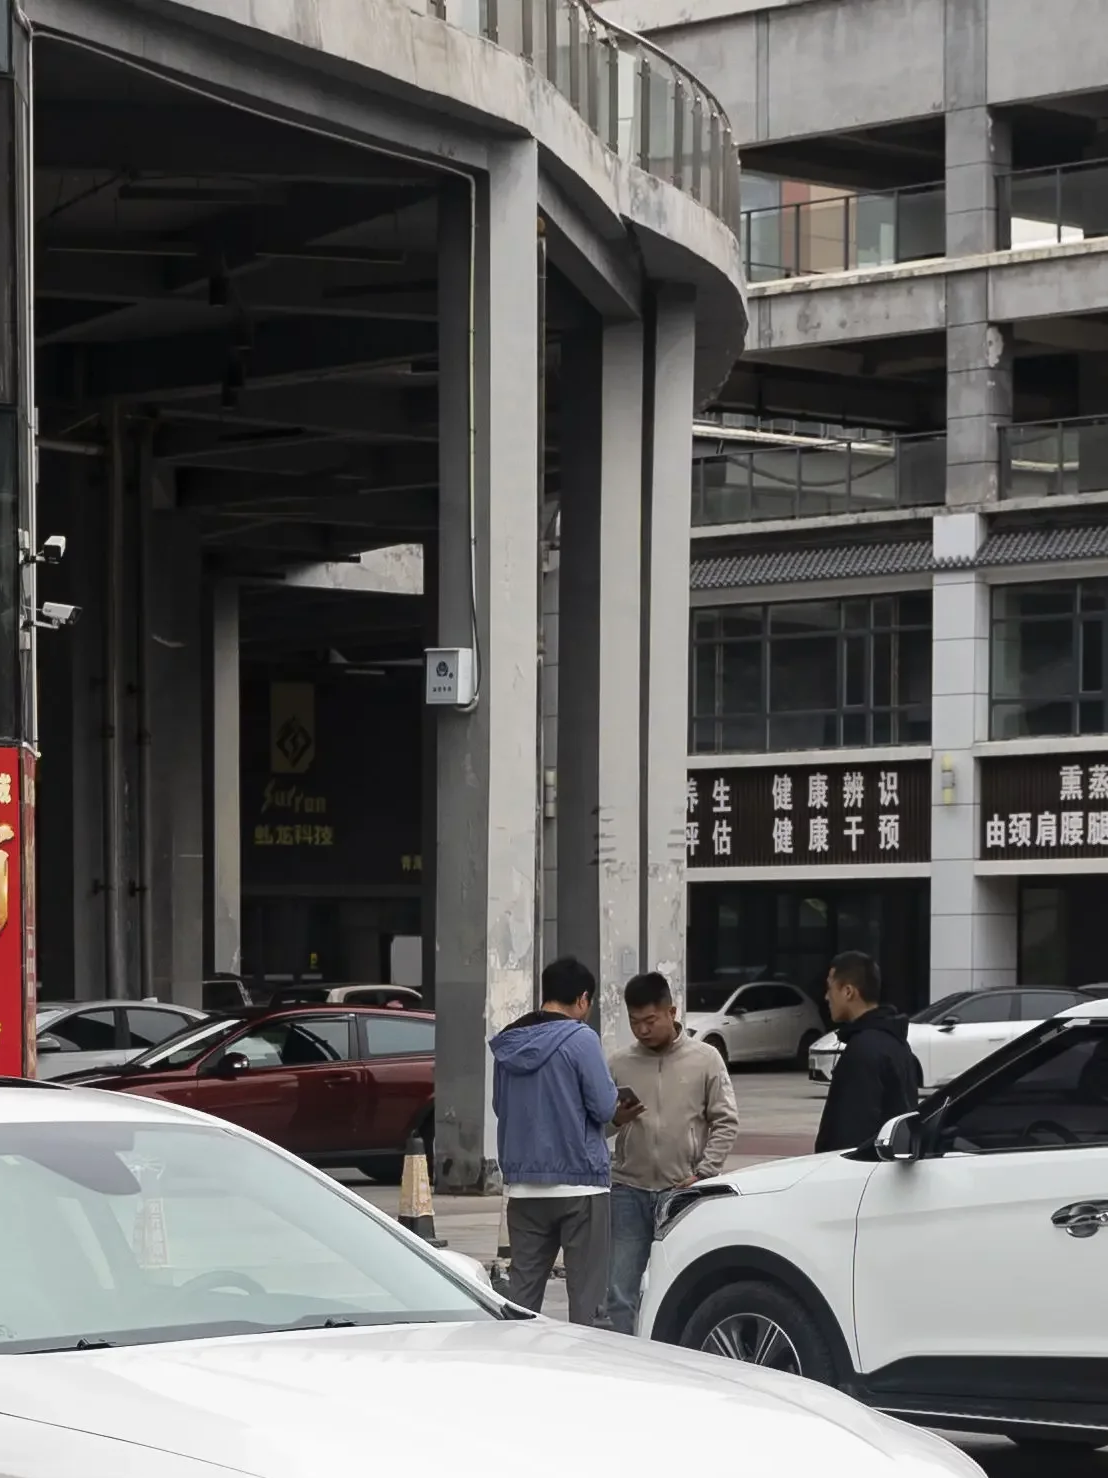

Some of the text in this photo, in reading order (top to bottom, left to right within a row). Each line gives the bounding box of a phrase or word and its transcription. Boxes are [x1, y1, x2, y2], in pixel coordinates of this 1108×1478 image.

[772, 771, 900, 811] 健康辨识
[772, 814, 900, 854] 健康干预
[986, 811, 1108, 849] 由颈肩腰腿
